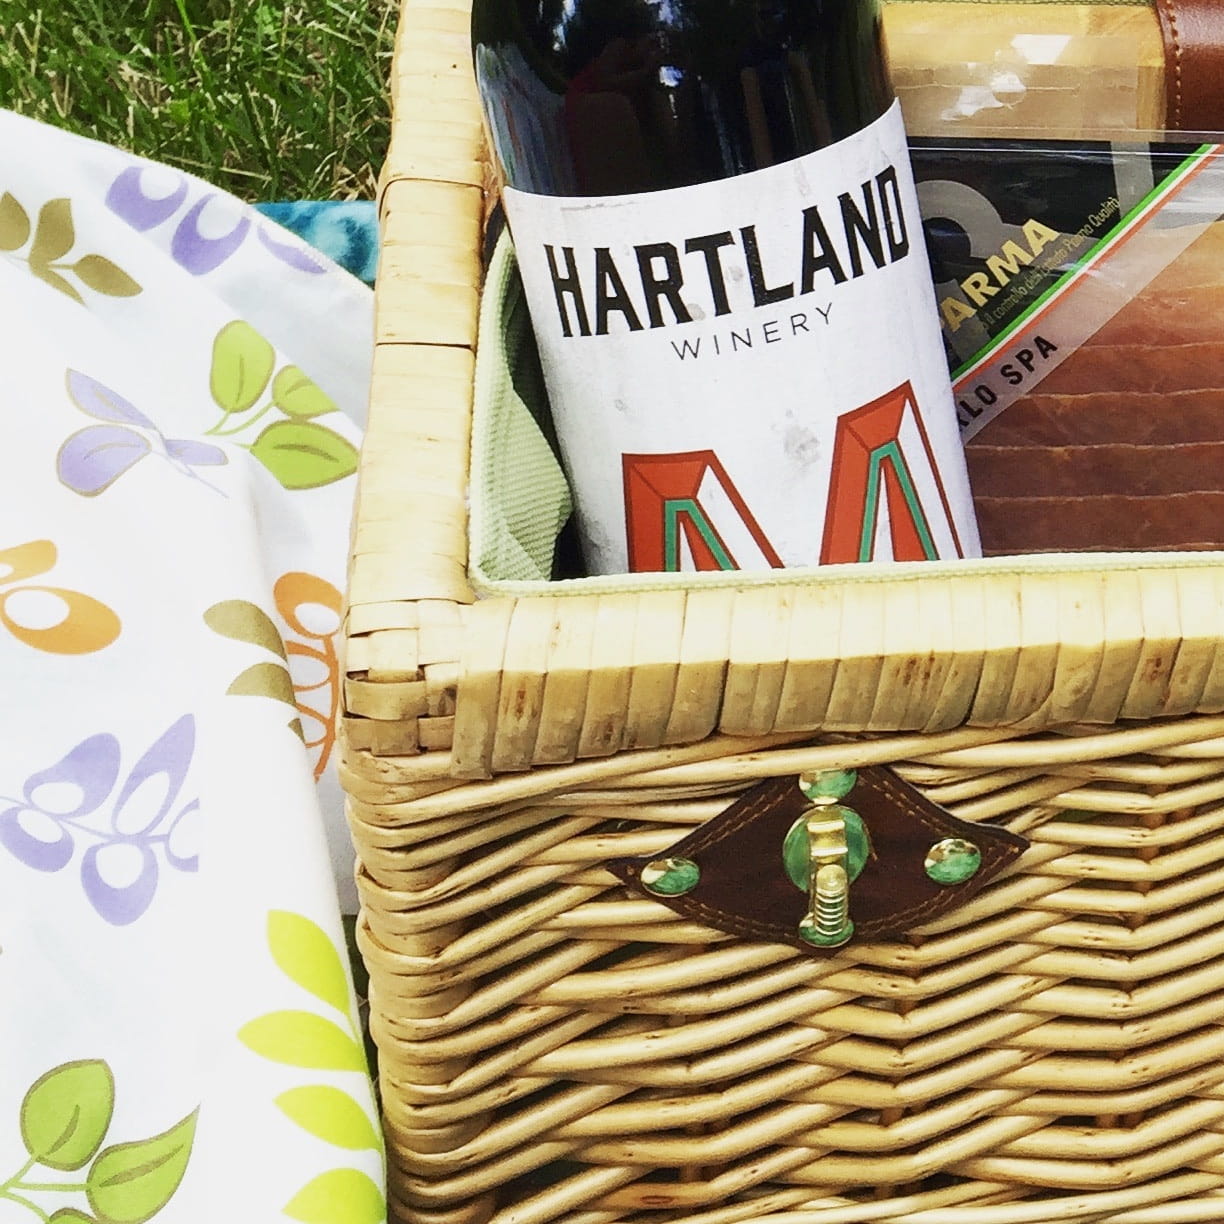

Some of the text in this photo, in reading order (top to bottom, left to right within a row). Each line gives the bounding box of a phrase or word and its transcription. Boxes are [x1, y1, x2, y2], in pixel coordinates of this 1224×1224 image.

[543, 164, 910, 338] HARTLAND
[940, 218, 1060, 332] ARMA
[670, 302, 834, 362] WINERY
[1000, 335, 1058, 385] SPA
